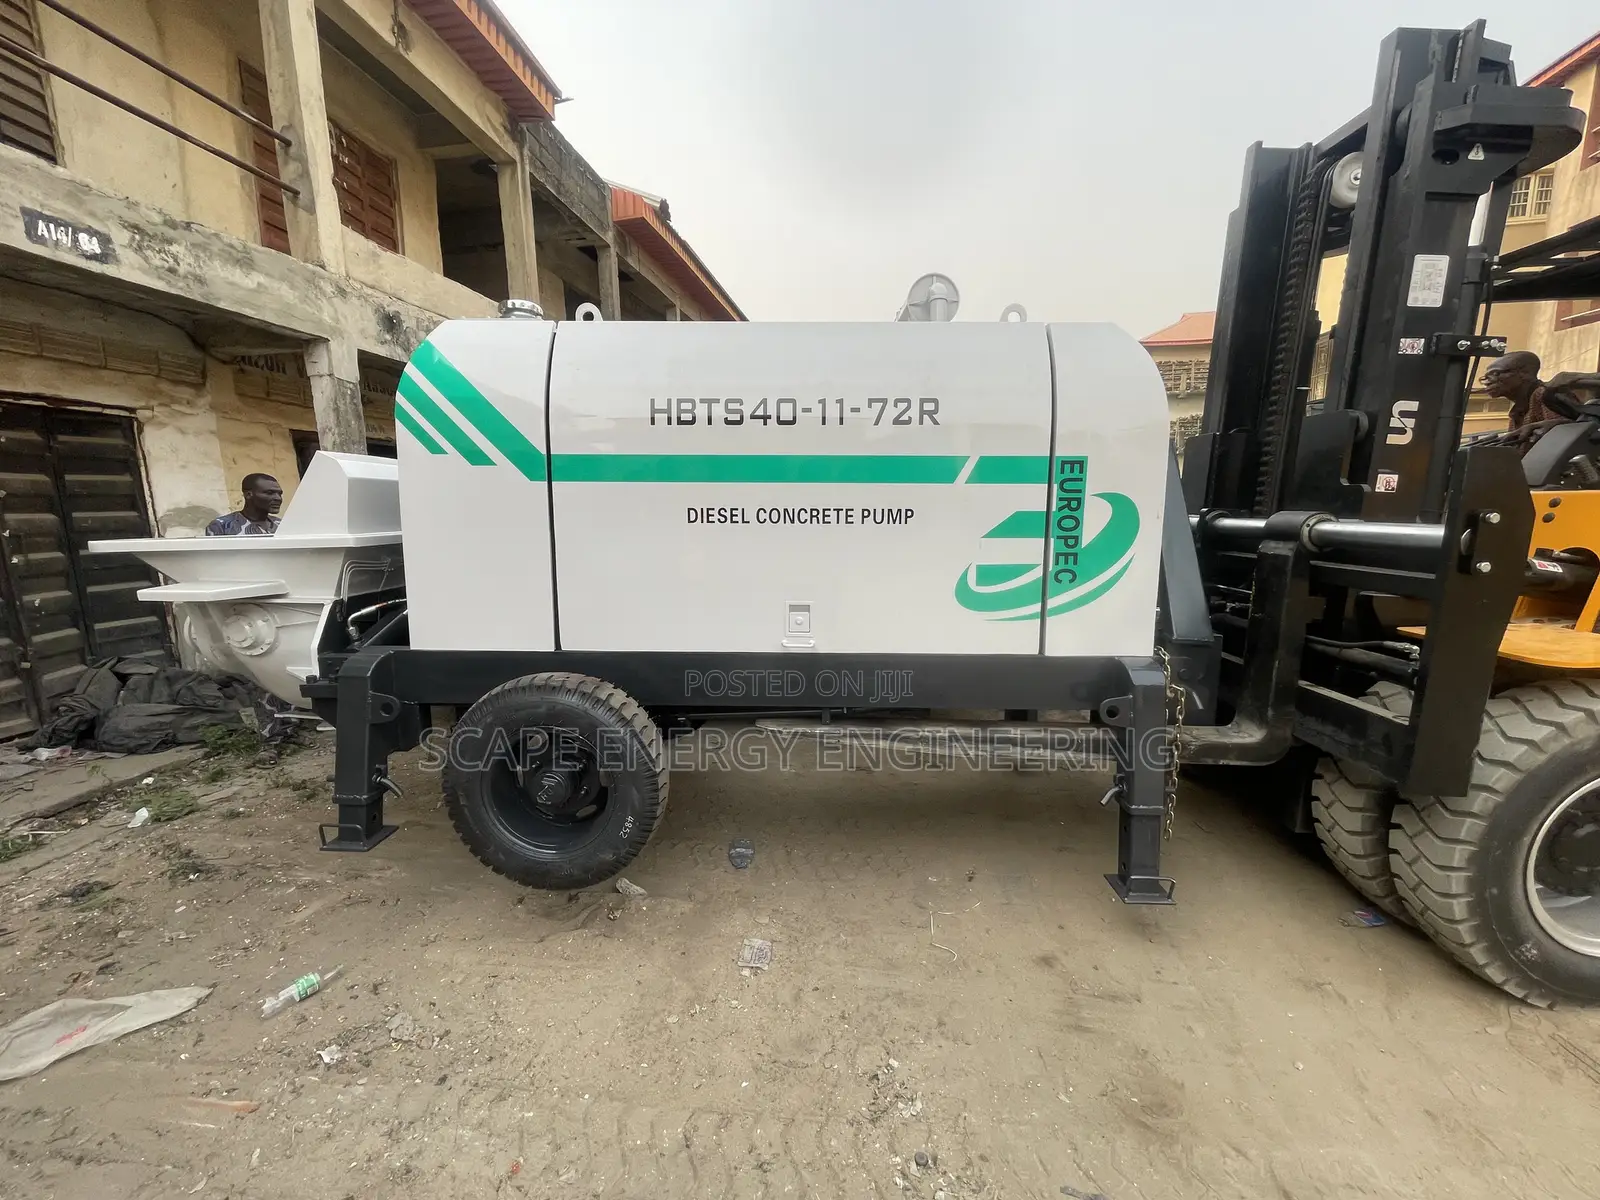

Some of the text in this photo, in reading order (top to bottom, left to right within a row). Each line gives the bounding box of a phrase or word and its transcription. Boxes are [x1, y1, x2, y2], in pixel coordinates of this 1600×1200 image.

[649, 397, 941, 427] HBTS40-11-72R
[686, 507, 915, 526] DIESEL CONCRETE PUMP
[1053, 459, 1085, 584] EUROPEC
[618, 815, 635, 839] 4852
